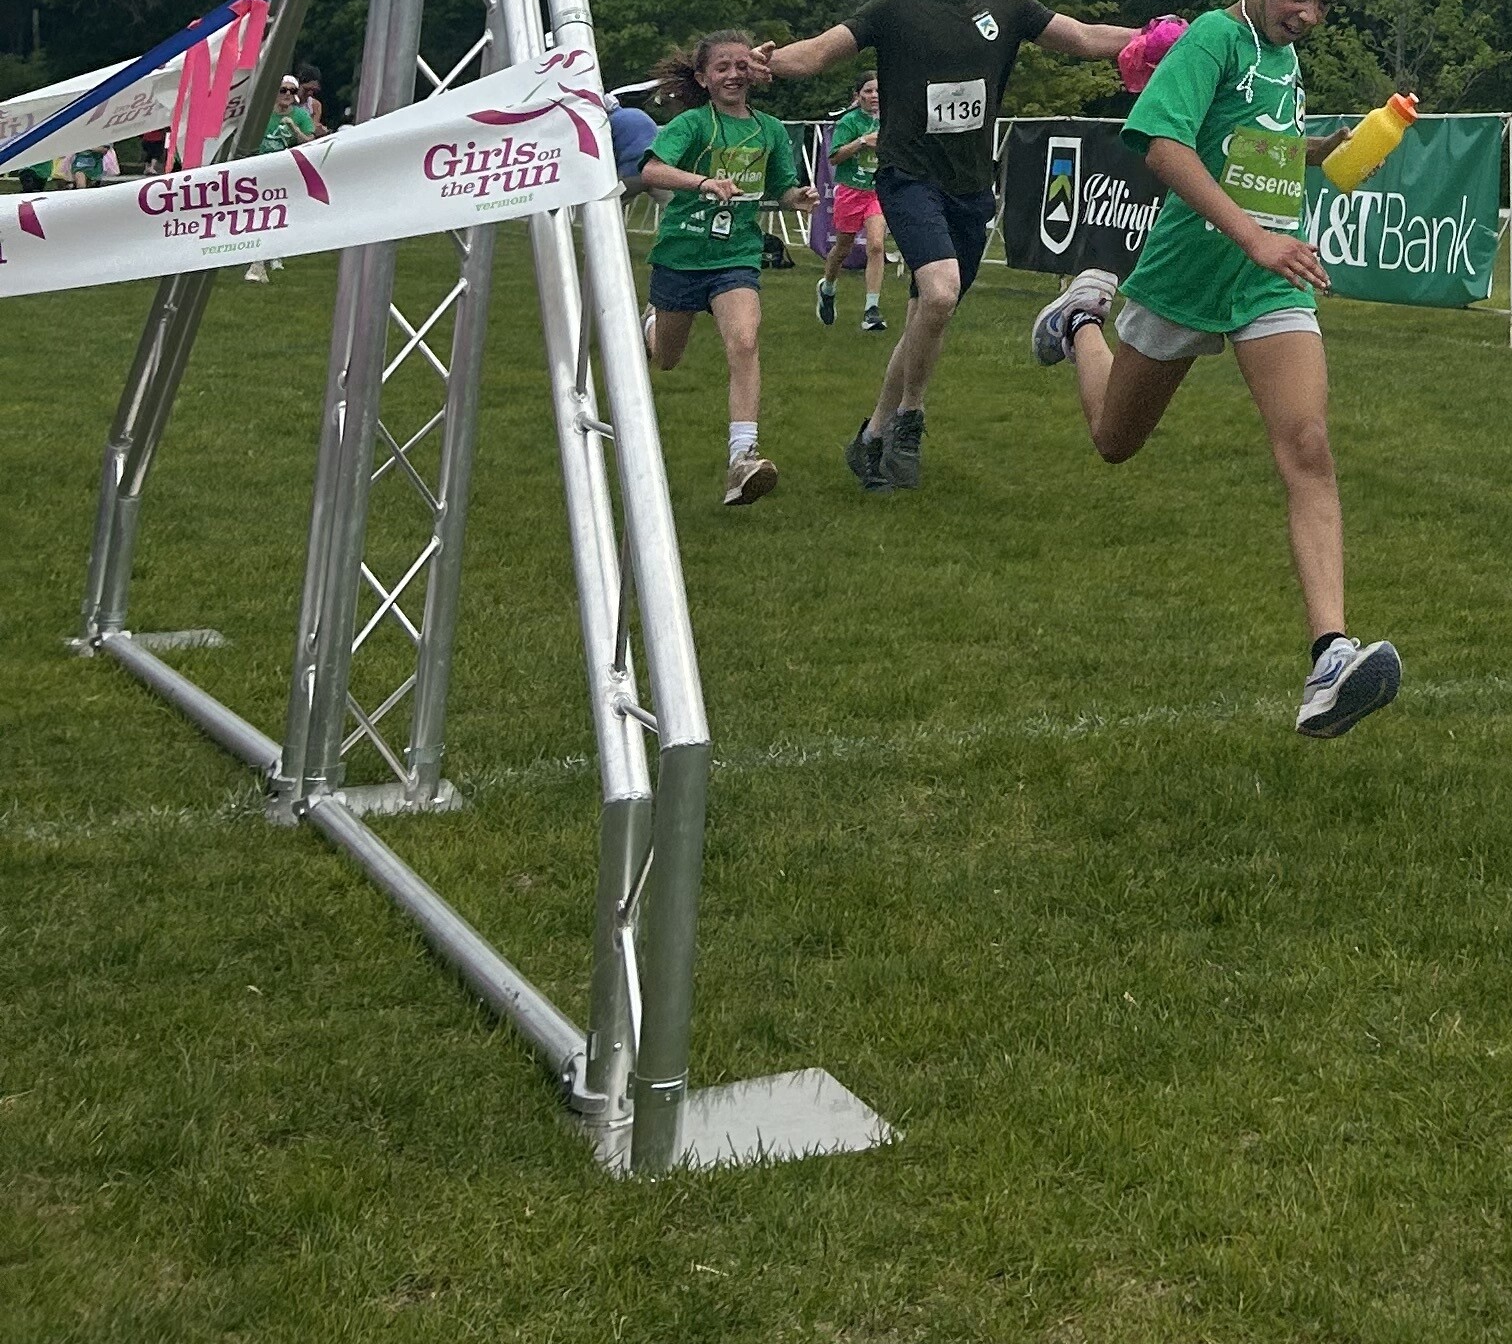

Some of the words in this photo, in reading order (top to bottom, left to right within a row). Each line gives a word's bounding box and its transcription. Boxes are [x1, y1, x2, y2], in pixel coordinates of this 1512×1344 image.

[934, 100, 982, 123] 1136
[423, 137, 538, 180] Girls
[538, 147, 561, 161] on
[138, 169, 259, 215] Girls
[262, 187, 288, 202] on
[441, 181, 475, 198] the
[473, 161, 560, 198] run
[1225, 163, 1302, 198] Essence
[475, 192, 534, 211] vermont
[163, 218, 199, 237] the
[199, 204, 288, 239] run
[1379, 192, 1477, 275] Bank
[201, 237, 261, 256] vermont
